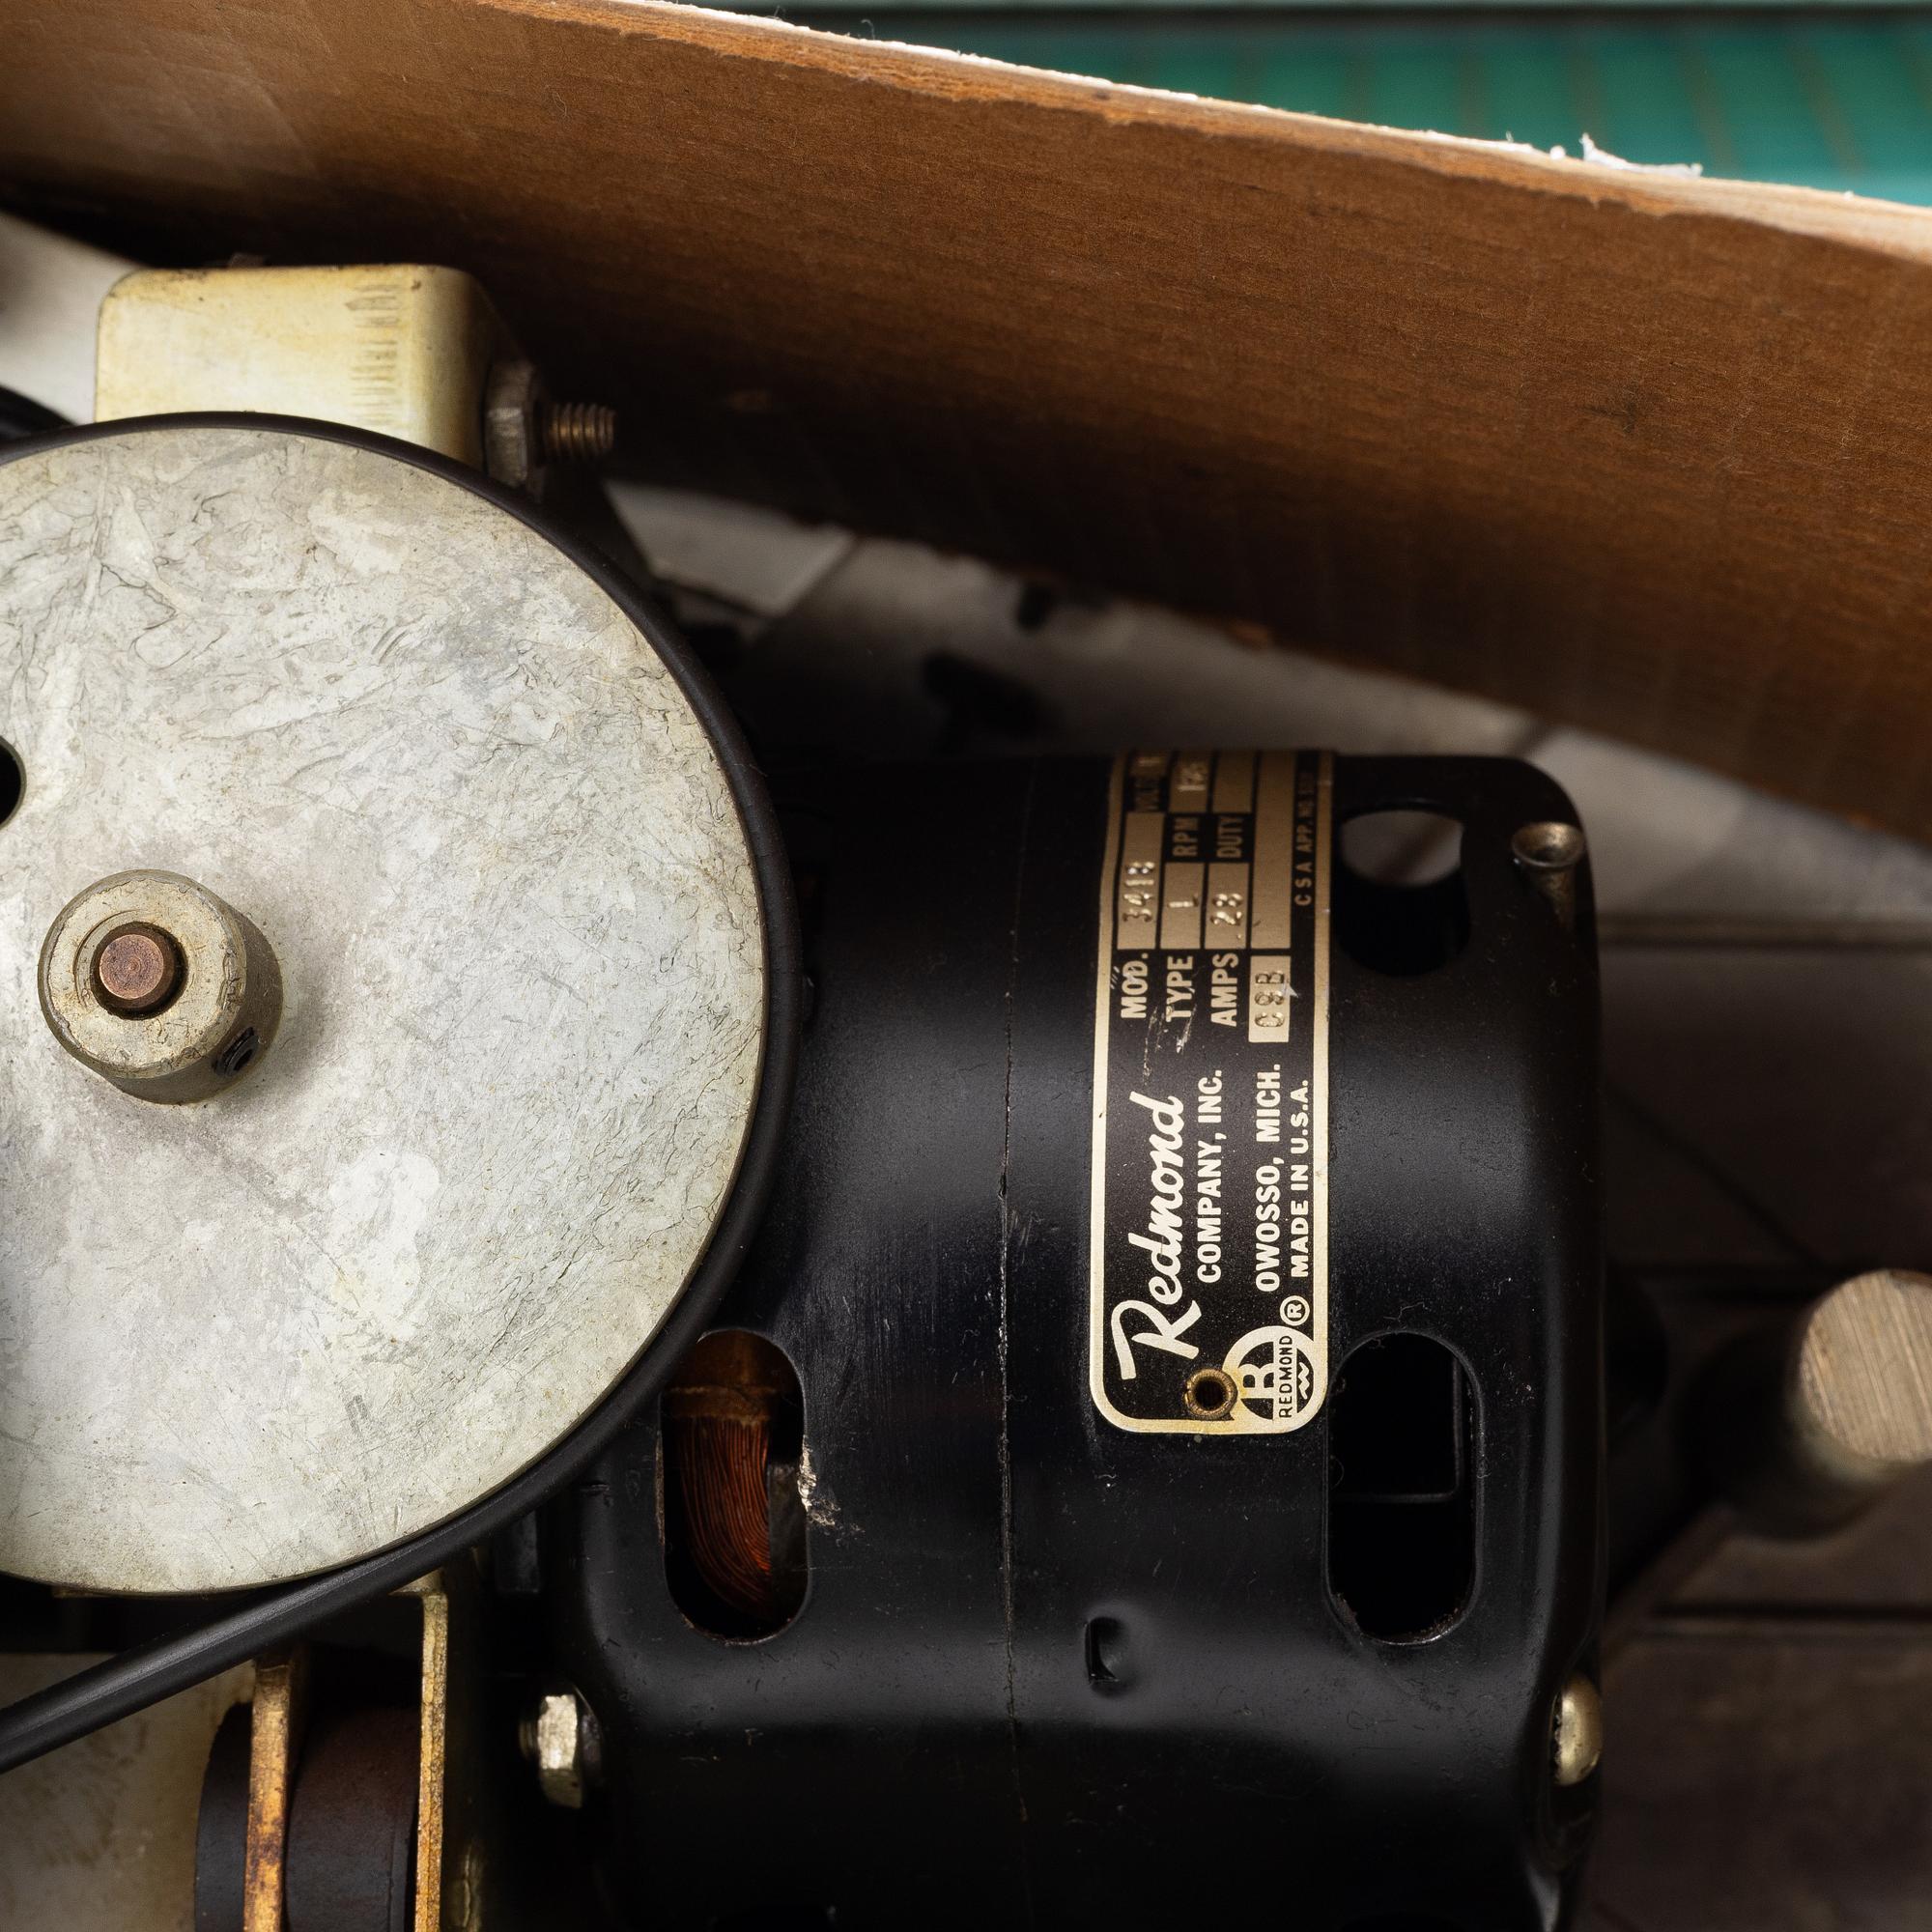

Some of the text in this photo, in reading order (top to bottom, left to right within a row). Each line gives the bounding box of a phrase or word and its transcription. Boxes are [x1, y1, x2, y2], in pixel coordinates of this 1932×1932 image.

[1173, 817, 1199, 857] RPM
[1216, 815, 1243, 858] DUTY
[1121, 952, 1149, 1019] MOD.
[1165, 955, 1194, 1022] TYPE
[1210, 952, 1239, 1027] AMPS
[1197, 1069, 1227, 1283] COMPANY, INC.
[1256, 1064, 1285, 1292] OWOSSO, MICH.
[1291, 1080, 1310, 1278] MADE IN U.S.A.
[1111, 1091, 1202, 1380] Redmond
[1278, 1335, 1293, 1419] REDMOND
